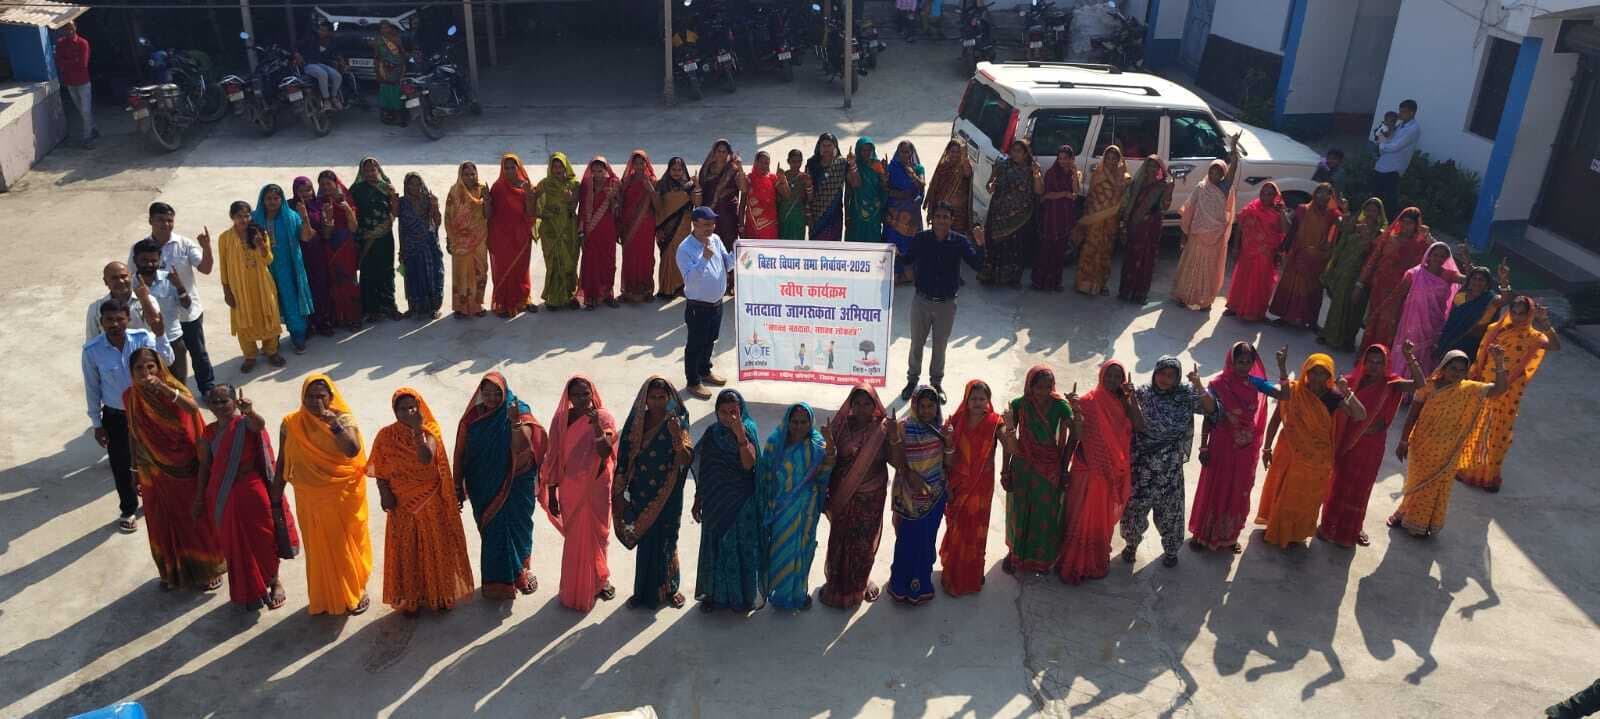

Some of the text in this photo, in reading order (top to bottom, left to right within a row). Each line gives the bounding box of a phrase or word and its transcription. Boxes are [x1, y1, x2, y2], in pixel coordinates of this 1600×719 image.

[758, 254, 777, 269] बिहार
[779, 254, 801, 270] विधान
[803, 258, 818, 271] सभा
[780, 282, 848, 298] स्वीप कार्यक्रम
[744, 303, 782, 317] मतदाता
[840, 303, 882, 322] अभियान
